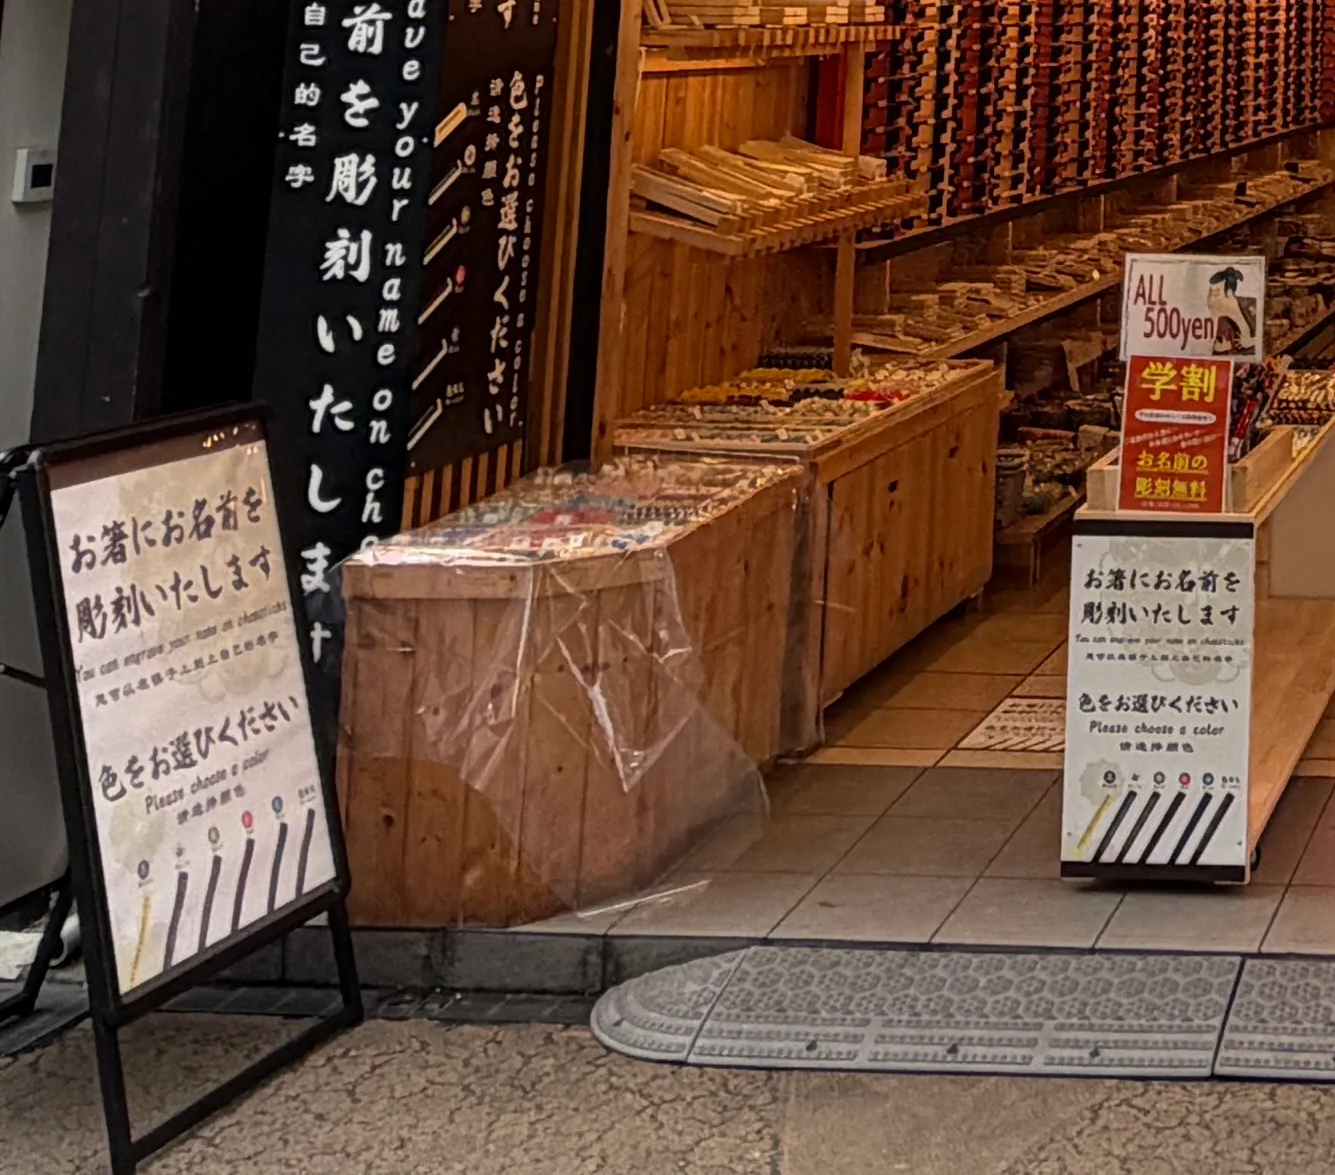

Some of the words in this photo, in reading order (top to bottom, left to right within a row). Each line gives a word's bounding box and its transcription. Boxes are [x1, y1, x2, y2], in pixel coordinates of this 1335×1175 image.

[392, 97, 420, 223] your
[481, 71, 530, 433] 色をお選びください
[374, 235, 408, 369] name
[1134, 273, 1167, 307] ALL
[1143, 307, 1215, 350] 500yen
[1141, 361, 1217, 404] 学割
[368, 385, 396, 447] on
[1135, 449, 1209, 471] お名前の
[71, 487, 263, 575] お箸にお名前を
[77, 546, 272, 644] 彫刻いたします
[1083, 568, 1243, 592] お箸にお名前を
[1080, 601, 1241, 626] 彫刻いたします
[1078, 692, 1240, 715] 色をお選びください
[1089, 719, 1129, 734] Please
[1134, 721, 1174, 735] choose
[1192, 723, 1225, 735] color
[98, 695, 300, 803] 色をお選びください
